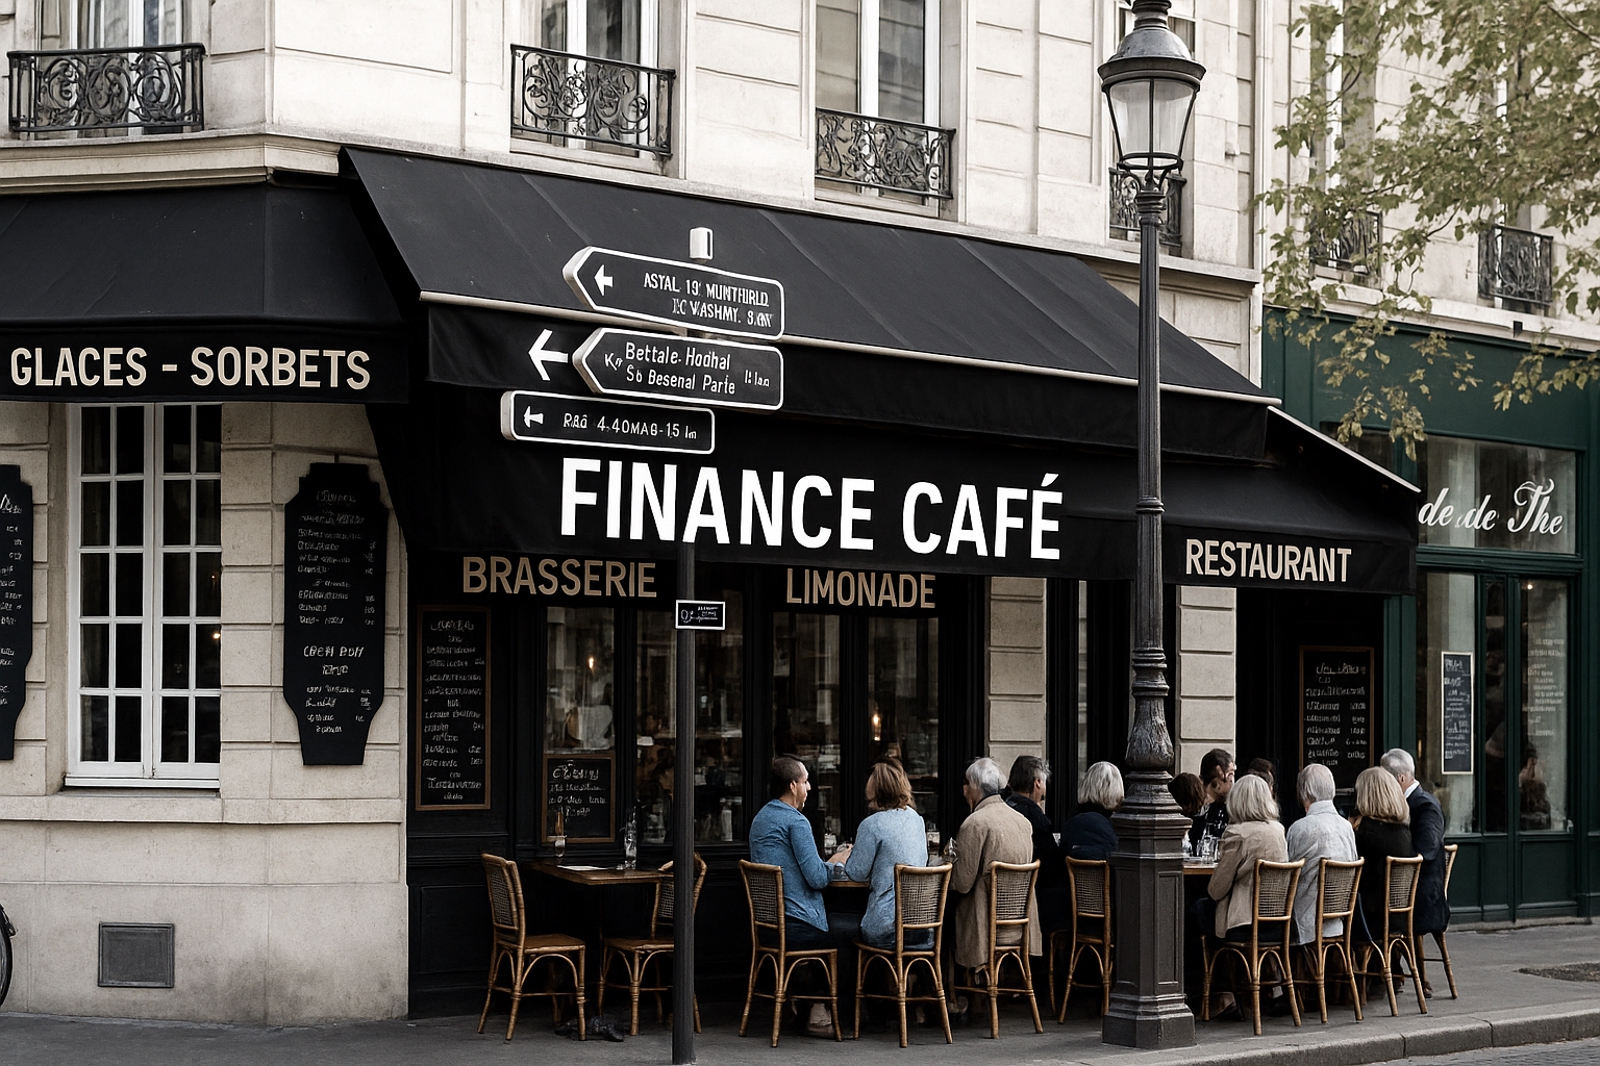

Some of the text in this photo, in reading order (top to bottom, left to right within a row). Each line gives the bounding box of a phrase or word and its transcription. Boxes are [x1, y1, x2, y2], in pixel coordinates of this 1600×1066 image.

[10, 346, 148, 388] GLACES
[190, 346, 371, 390] SORBETS
[648, 369, 696, 391] Besenal
[560, 457, 1064, 561] FINANCE CAFÉ
[1418, 487, 1454, 527] de
[1507, 478, 1564, 535] The
[462, 556, 657, 599] BRASSERIE
[1185, 538, 1352, 584] RESTAURANT
[785, 568, 937, 610] LIMONADE
